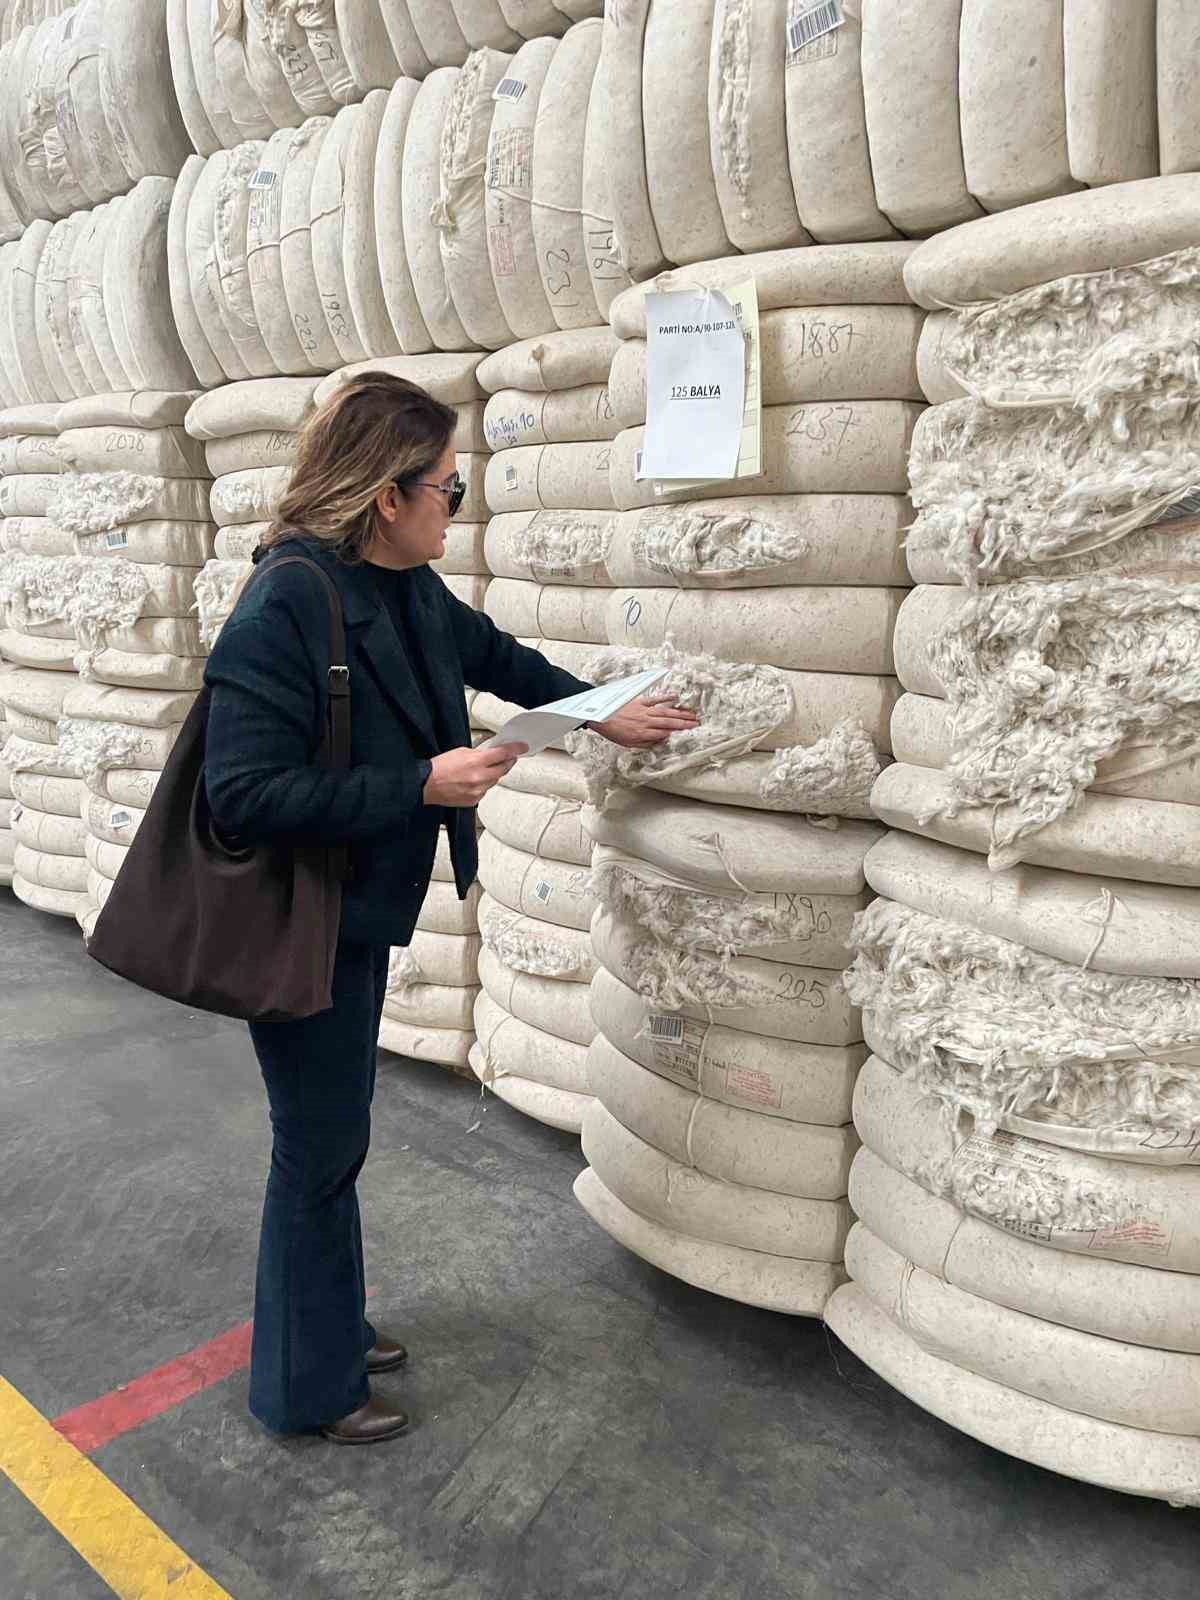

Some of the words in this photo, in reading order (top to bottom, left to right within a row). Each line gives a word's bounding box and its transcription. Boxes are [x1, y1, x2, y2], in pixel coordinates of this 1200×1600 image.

[545, 248, 579, 308] 231
[659, 323, 680, 334] PARTİ
[801, 322, 860, 358] 1887
[671, 385, 688, 398] 125
[690, 384, 721, 397] BALYA
[786, 406, 858, 460] 237
